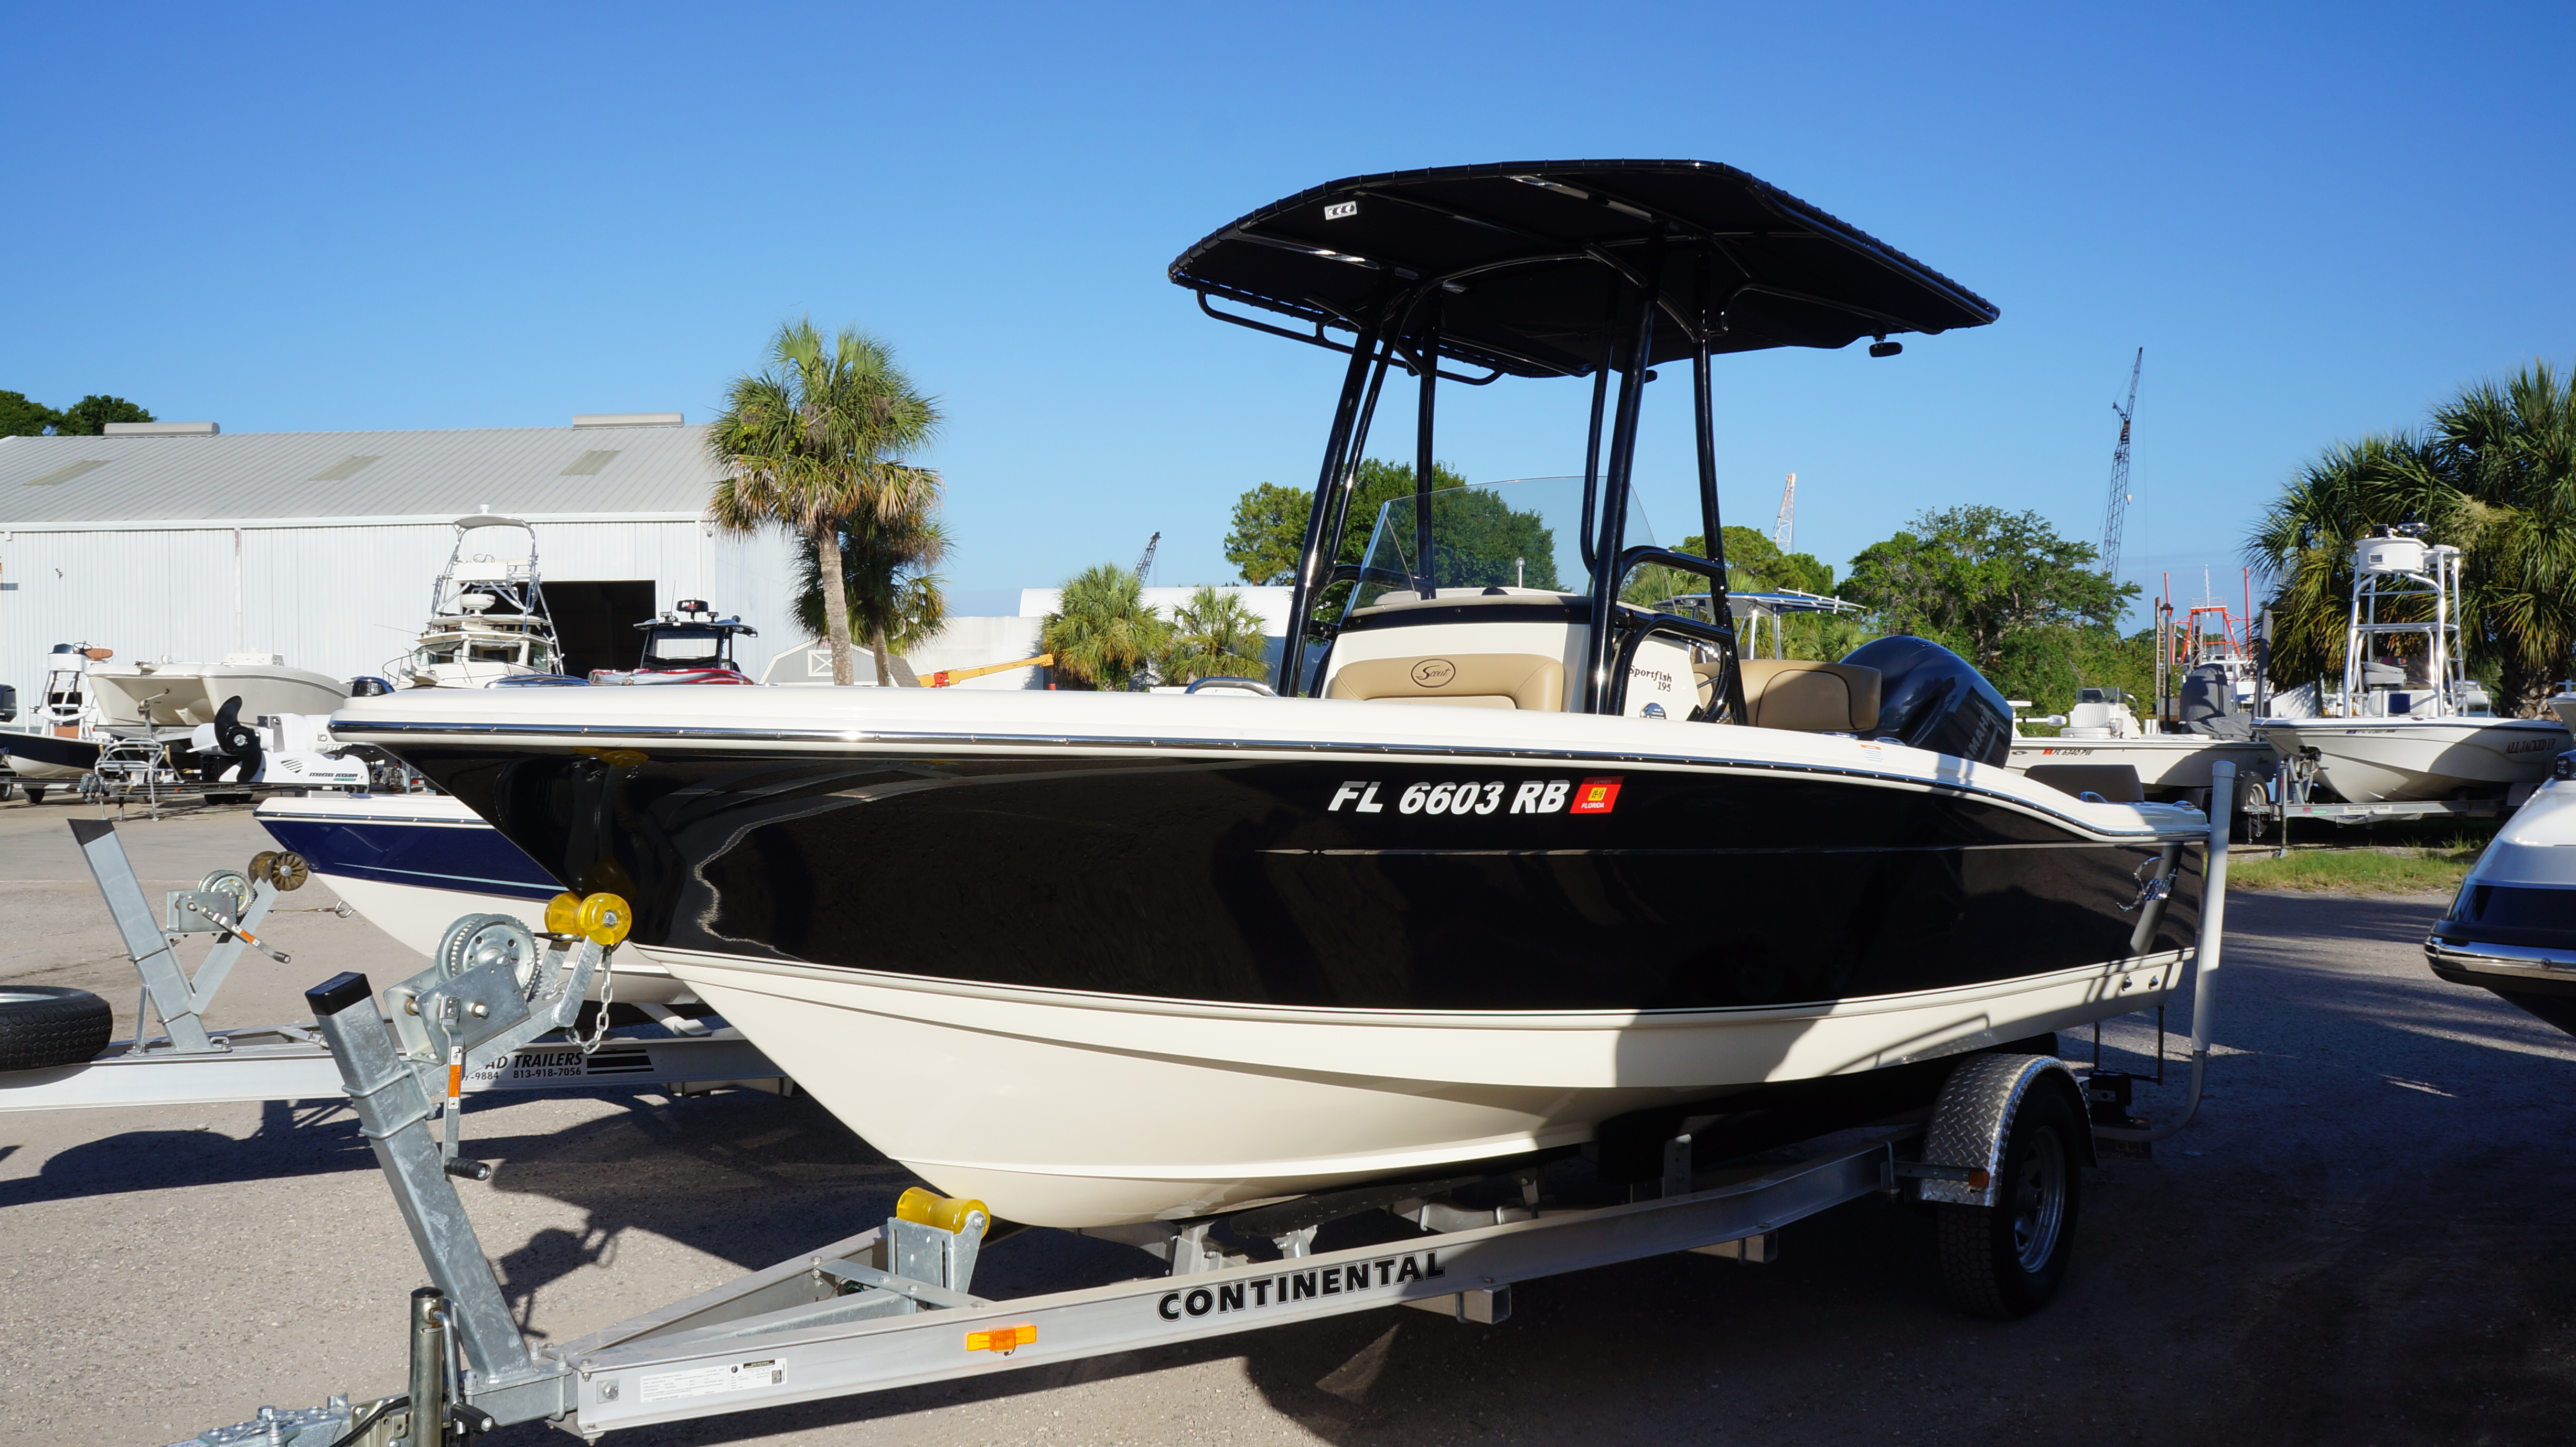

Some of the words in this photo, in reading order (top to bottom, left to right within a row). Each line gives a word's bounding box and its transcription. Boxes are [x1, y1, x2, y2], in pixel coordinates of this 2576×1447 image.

[1415, 665, 1452, 680] Scout
[1629, 665, 1672, 683] Sportfish
[1657, 682, 1671, 692] 195
[1963, 704, 1997, 760] AMAHA
[2547, 738, 2557, 750] UP
[1327, 781, 1384, 813] FL
[1399, 781, 1505, 815] 6603
[1509, 780, 1570, 814] RB
[485, 1056, 508, 1069] AD
[513, 1052, 583, 1068] TRAILERS
[513, 1068, 582, 1078] 813-918-7056
[1157, 1250, 1446, 1322] CONTINENTAL
